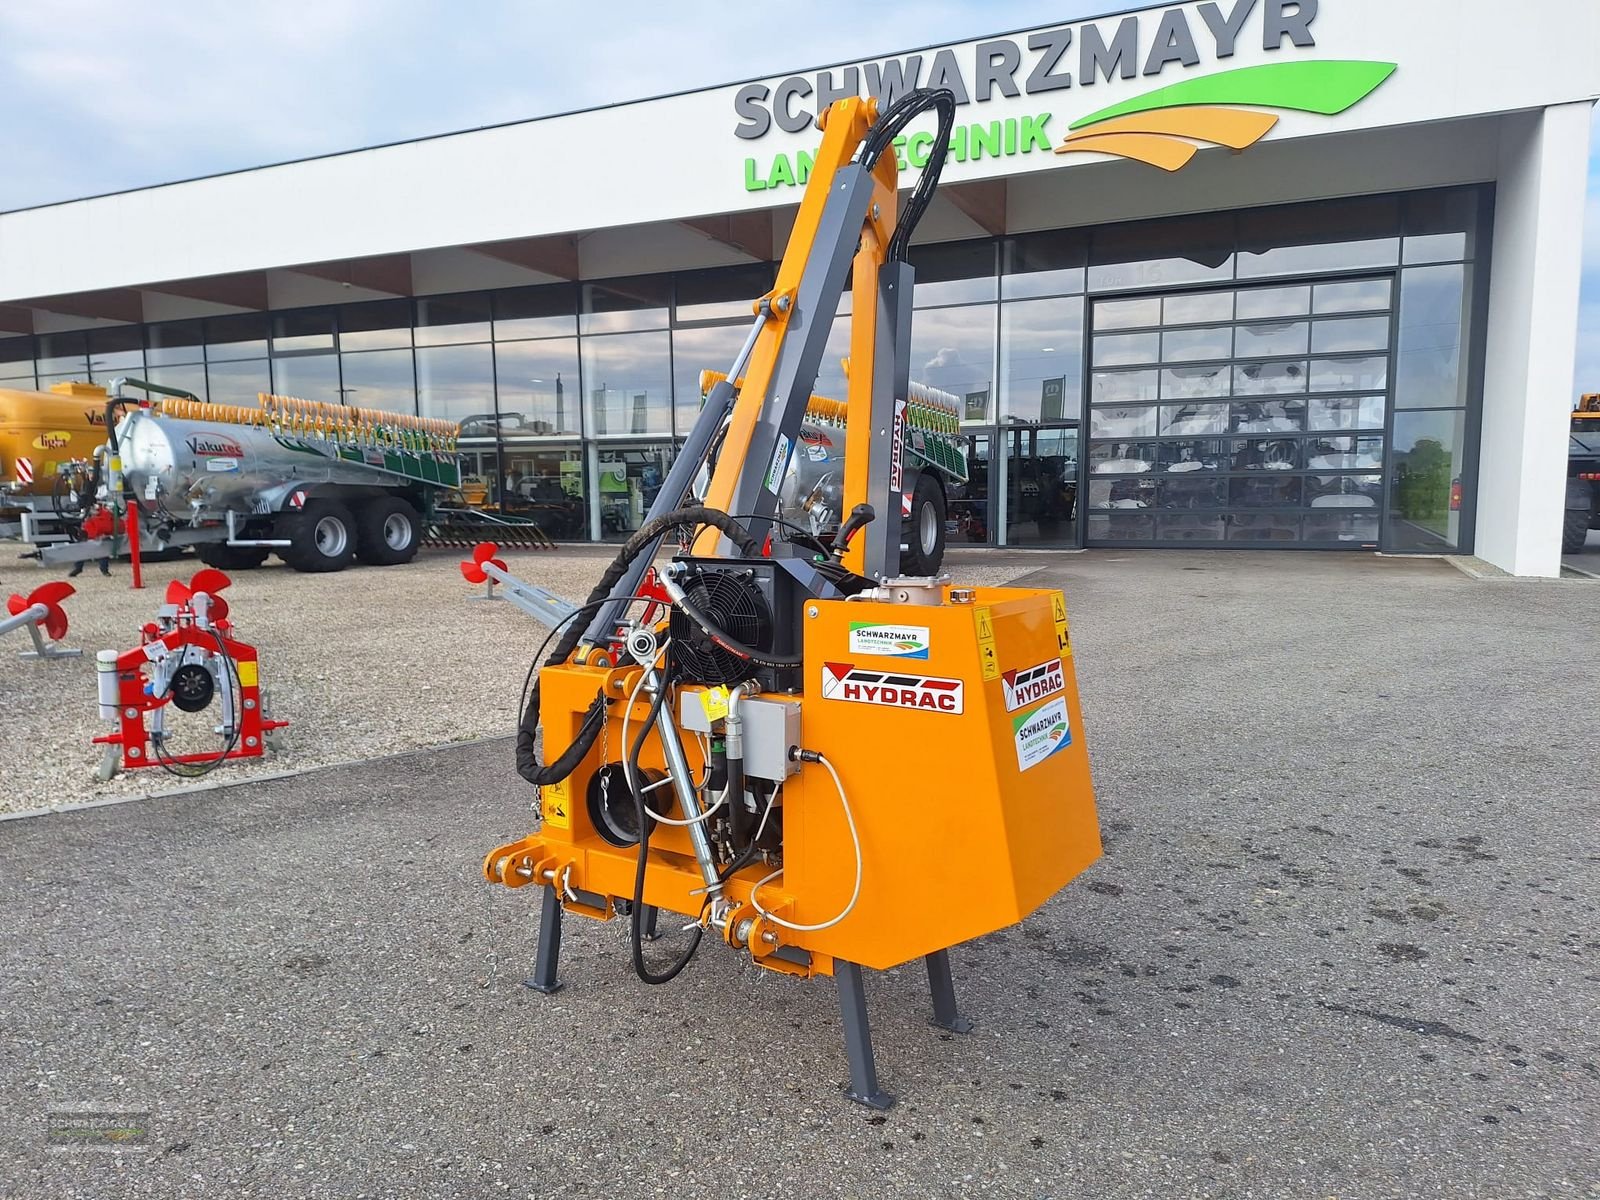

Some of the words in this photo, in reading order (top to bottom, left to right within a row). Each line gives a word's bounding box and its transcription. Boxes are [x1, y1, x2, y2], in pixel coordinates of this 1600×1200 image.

[734, 0, 1318, 139] SCHWARZMAYR
[745, 113, 1052, 191] LANECHNIK
[185, 437, 242, 454] Vakutec
[891, 415, 900, 487] HYDRAC
[856, 630, 918, 641] SCHWARZMAYR
[844, 683, 955, 711] HYDRAC
[1015, 673, 1062, 706] HYDRAC
[1020, 711, 1062, 741] SCHWARZMAYR
